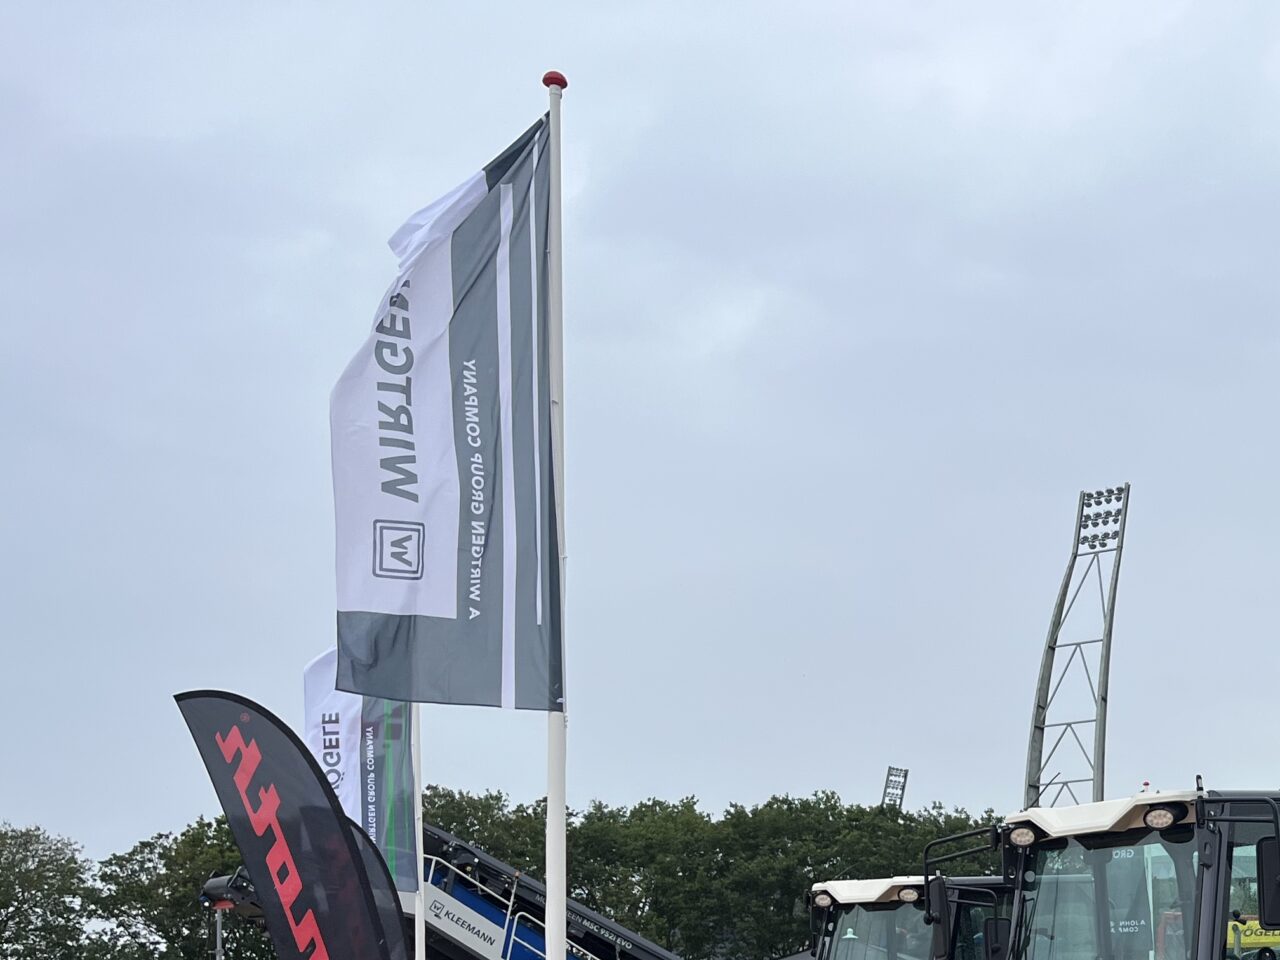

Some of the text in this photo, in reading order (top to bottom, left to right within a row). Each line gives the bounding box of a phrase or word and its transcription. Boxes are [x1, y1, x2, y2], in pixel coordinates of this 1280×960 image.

[444, 910, 496, 946] KLEEMANN
[582, 919, 600, 932] MSC
[616, 938, 633, 949] EVO
